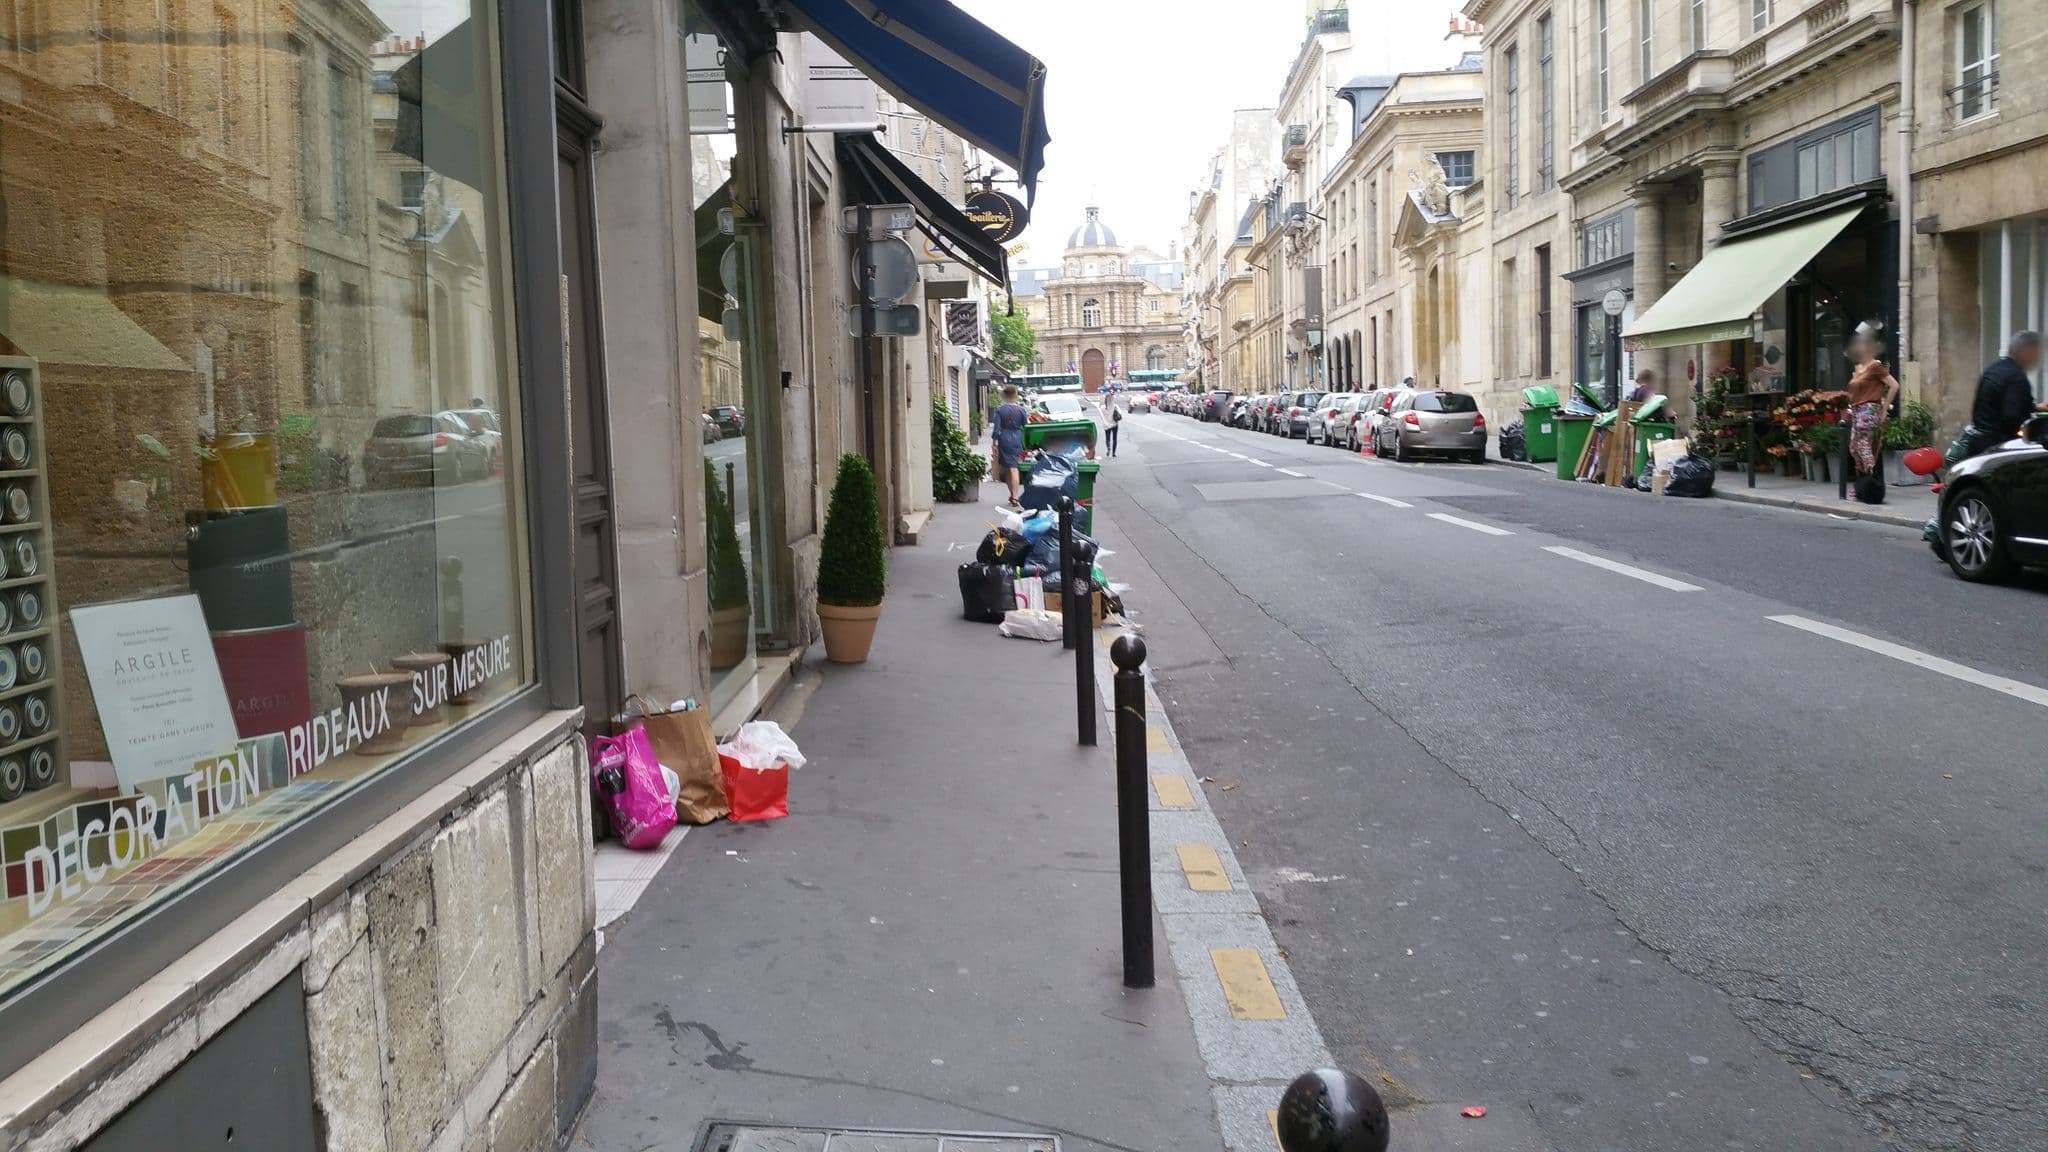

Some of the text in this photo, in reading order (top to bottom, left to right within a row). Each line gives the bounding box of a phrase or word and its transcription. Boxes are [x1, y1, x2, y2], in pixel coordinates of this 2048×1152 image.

[113, 648, 193, 676] ARGILE
[412, 634, 512, 716] SUR MESURE
[289, 686, 391, 778] RIDEAUX
[24, 743, 261, 918] DECORATION
